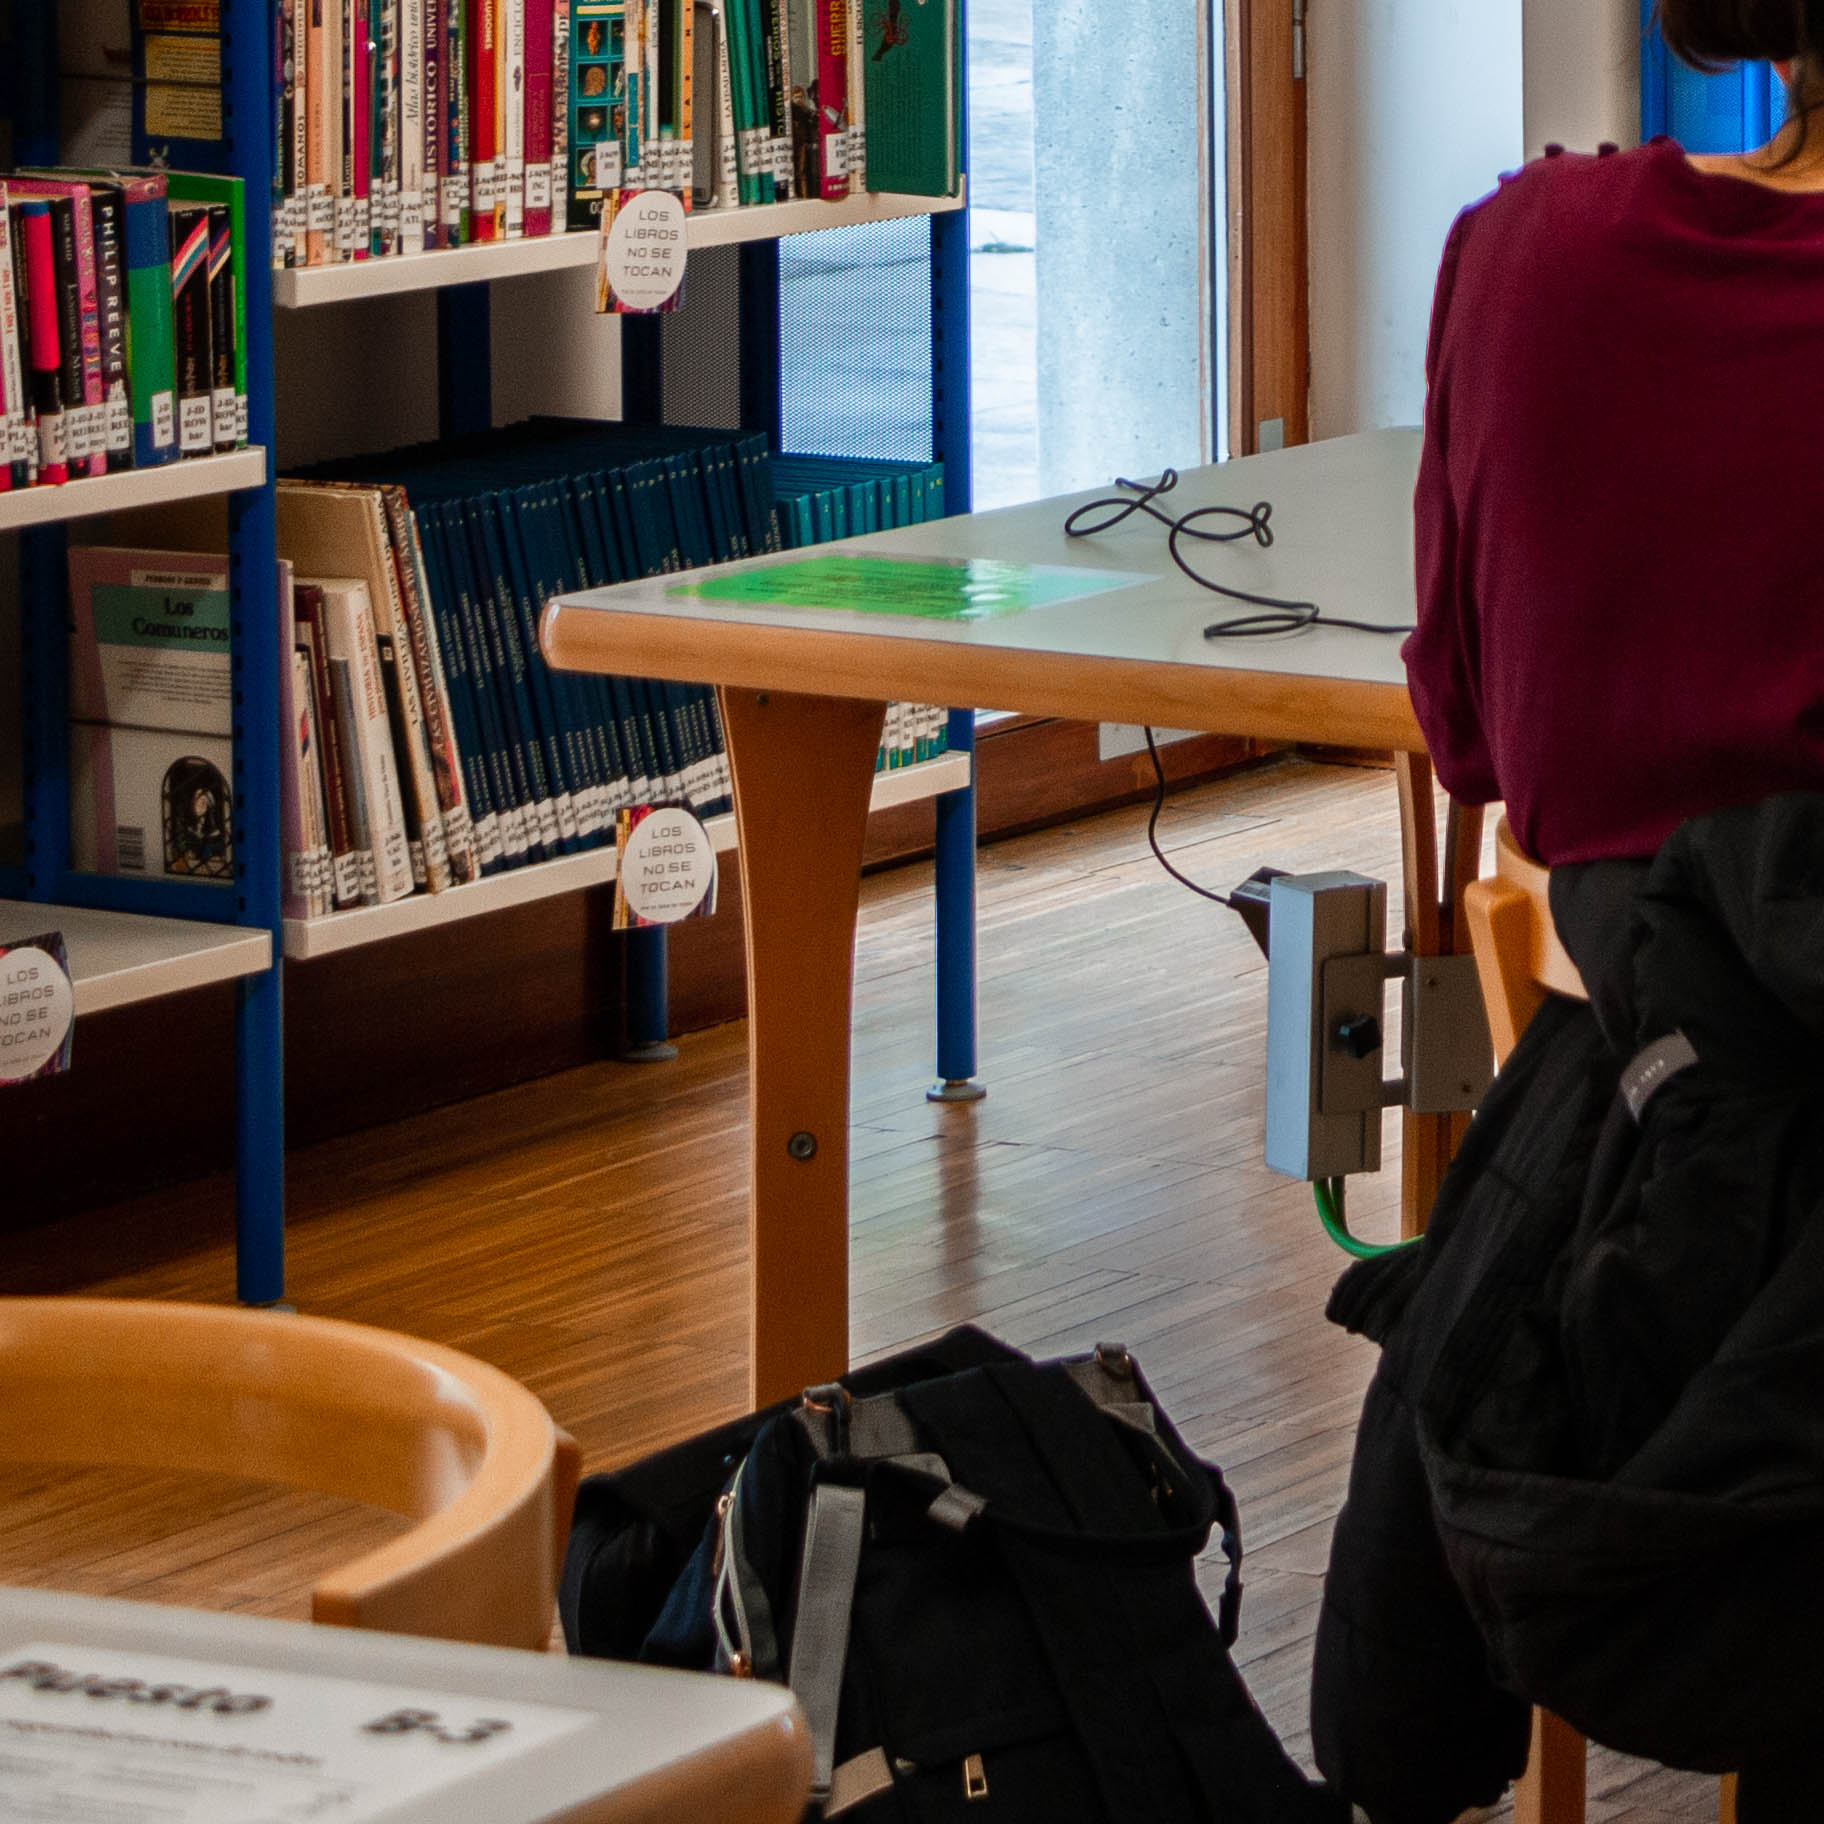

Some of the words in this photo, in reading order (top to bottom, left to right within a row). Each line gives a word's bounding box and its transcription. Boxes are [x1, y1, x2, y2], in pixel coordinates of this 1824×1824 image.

[557, 11, 568, 32] DE
[404, 88, 419, 125] Atlas
[639, 210, 670, 221] LOS
[625, 228, 679, 240] LIBROS
[102, 206, 117, 286] PHILIP
[628, 247, 646, 258] NO
[651, 247, 671, 258] SE
[623, 265, 672, 277] TOCAN
[107, 296, 122, 373] REEVE
[165, 597, 194, 616] Los
[132, 617, 229, 641] Comuneros
[652, 826, 682, 839] LOS
[638, 843, 696, 858] LIBROS
[643, 864, 665, 875] NO
[668, 861, 692, 872] SE
[640, 879, 695, 893] TOCAN
[7, 967, 39, 984] LOS
[0, 1013, 21, 1026] NO
[26, 1007, 48, 1022] SE
[0, 1660, 274, 1715] Puesto
